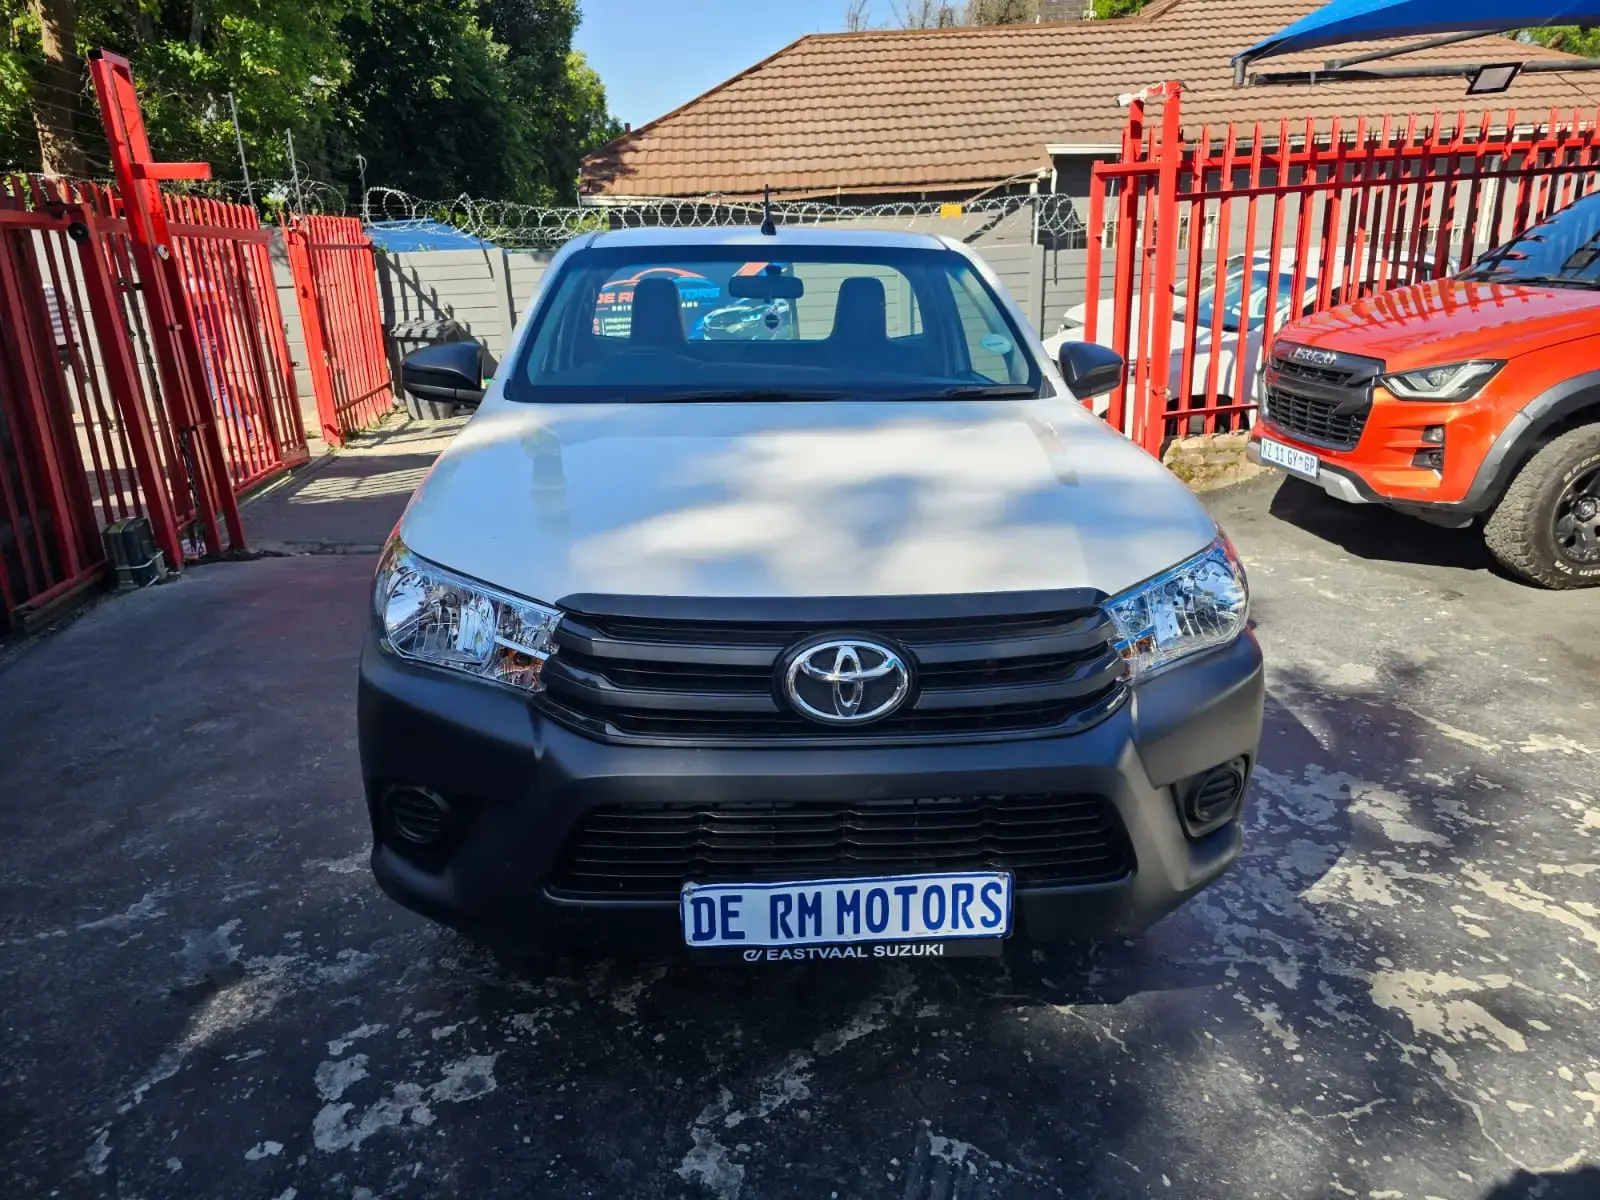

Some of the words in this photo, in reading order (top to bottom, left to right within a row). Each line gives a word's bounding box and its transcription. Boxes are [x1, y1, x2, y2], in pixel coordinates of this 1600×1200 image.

[678, 288, 720, 299] TORS
[1288, 347, 1337, 364] ISUZU
[1263, 440, 1272, 458] KZ
[1275, 445, 1284, 462] 11
[1288, 450, 1298, 467] GY
[1305, 456, 1315, 473] GP
[690, 894, 745, 942] DE
[770, 891, 822, 940] RM
[836, 882, 1003, 936] MOTORS
[767, 945, 868, 961] EASTVAAL
[873, 943, 944, 958] SUZUKI
